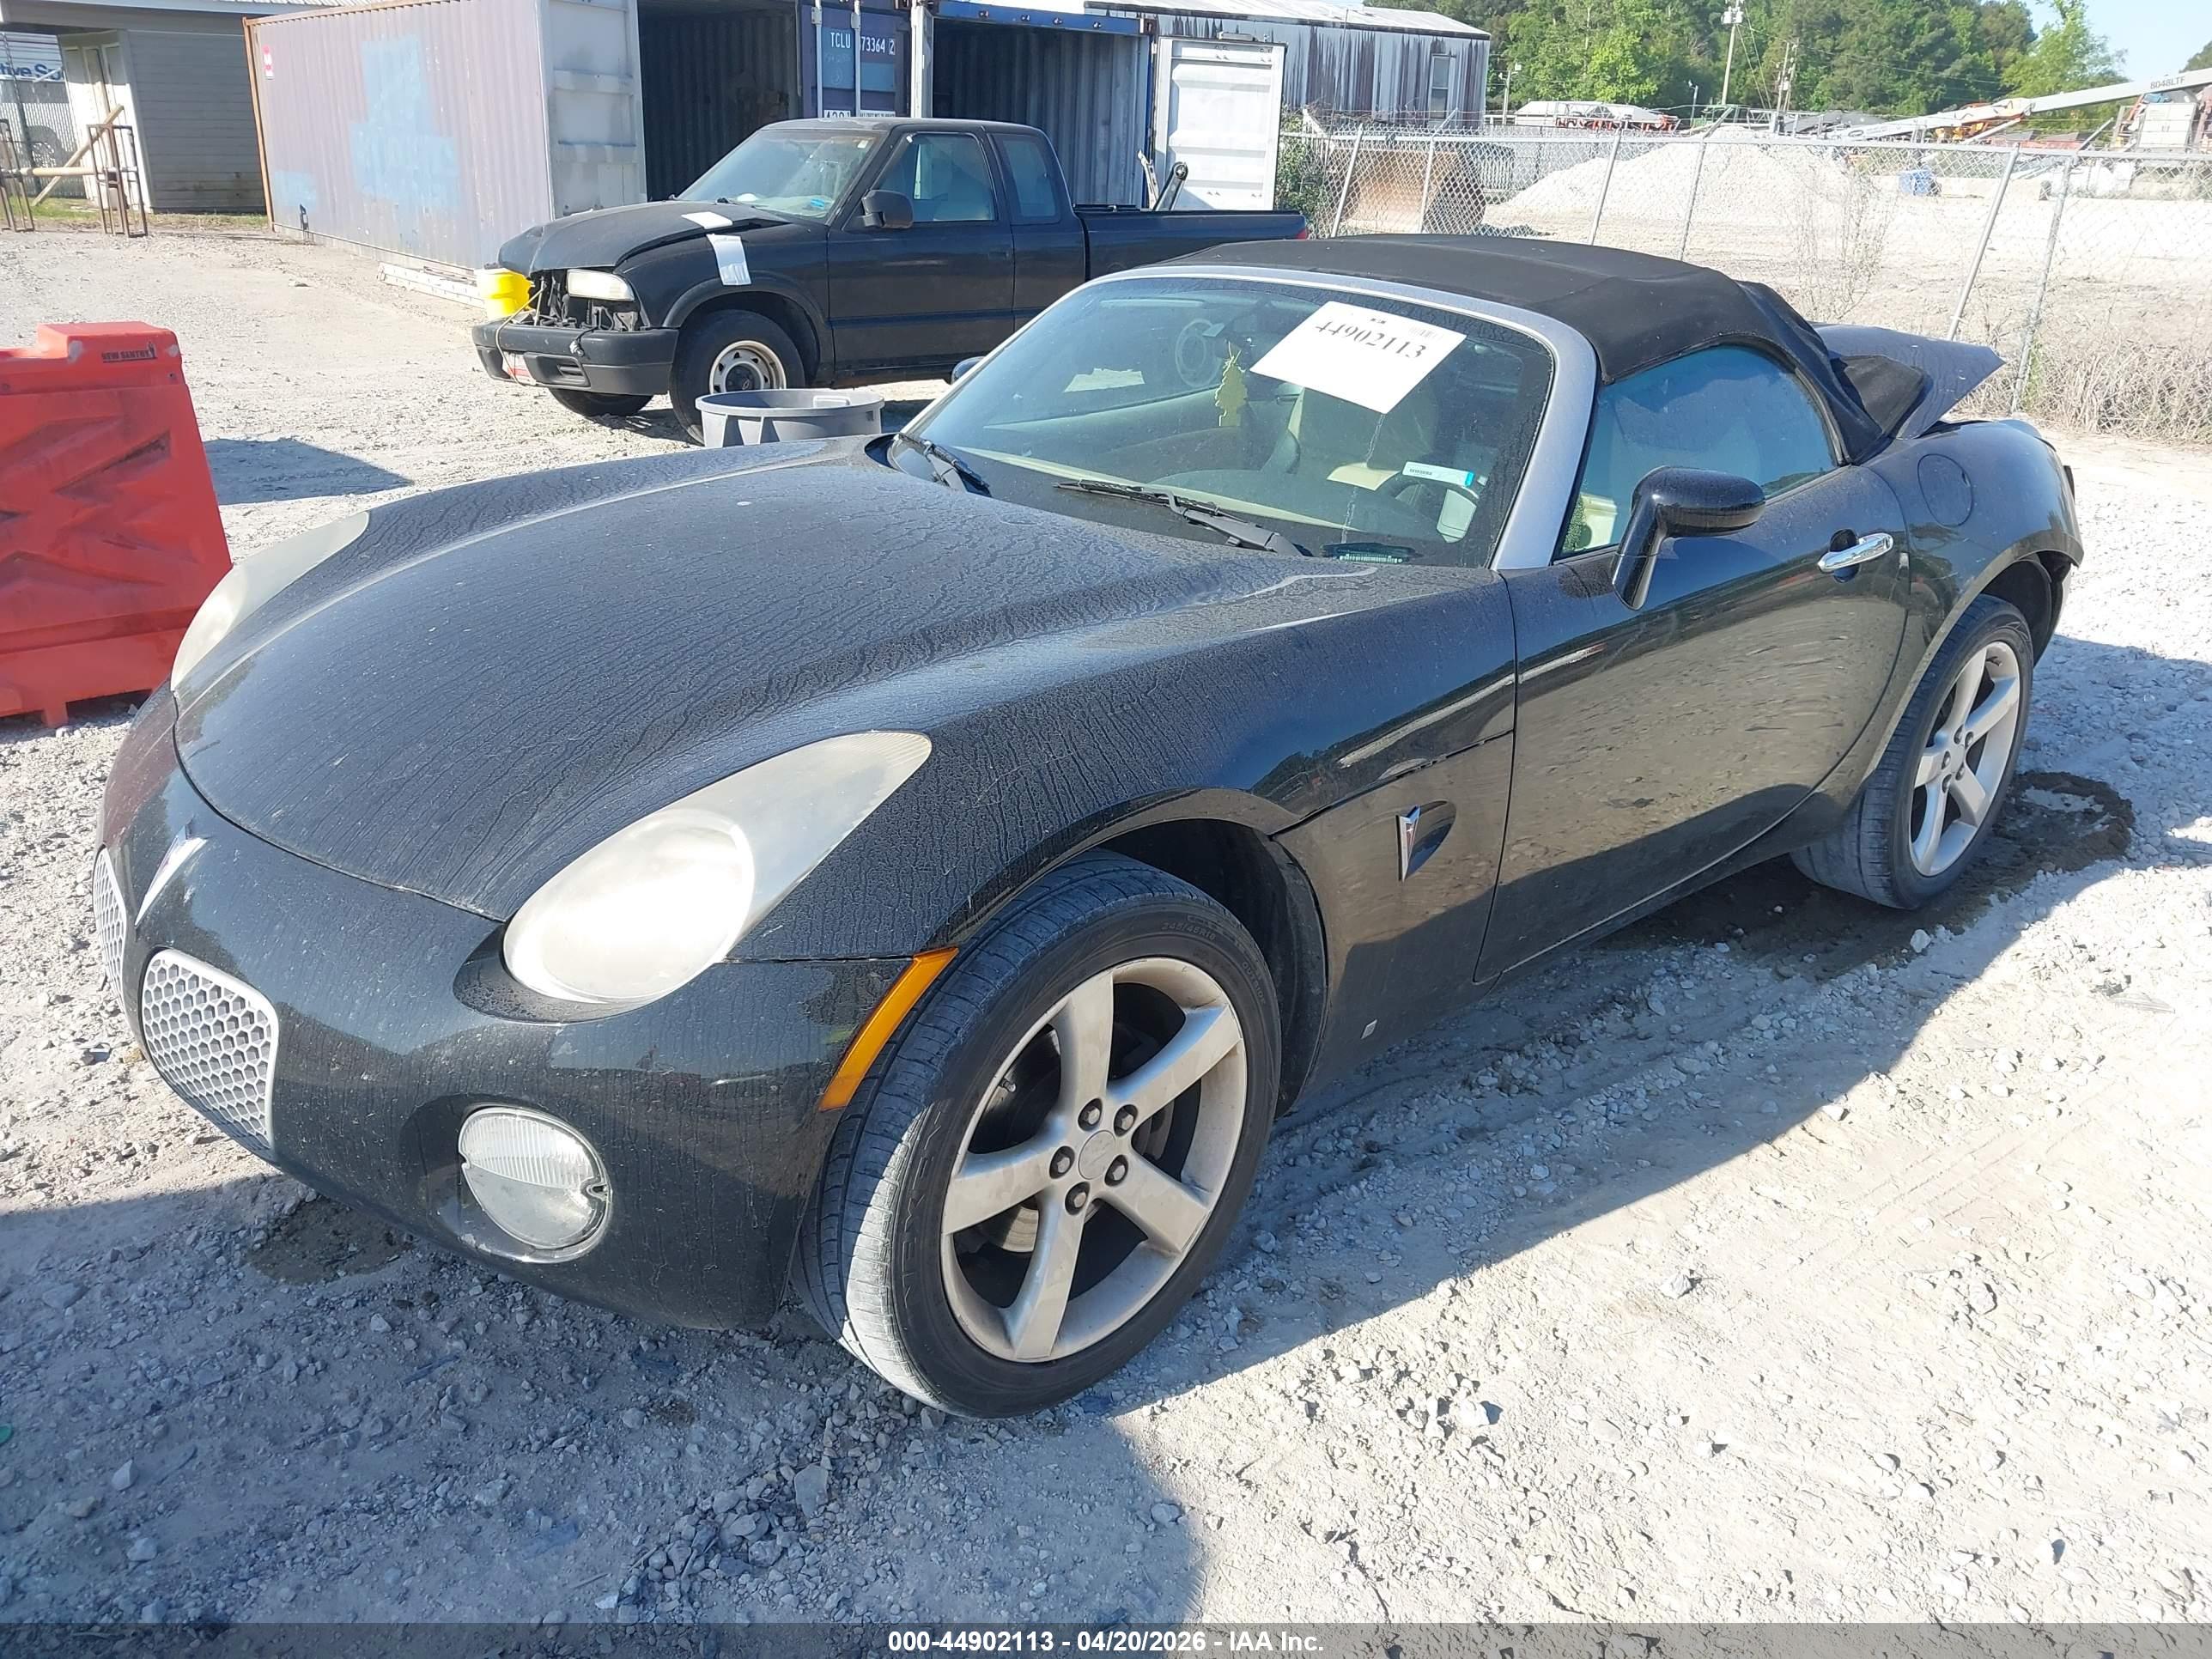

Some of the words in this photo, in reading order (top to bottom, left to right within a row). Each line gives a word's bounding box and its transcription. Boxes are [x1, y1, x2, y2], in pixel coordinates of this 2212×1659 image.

[830, 32, 851, 49] TCLU
[859, 36, 886, 53] 73364
[1316, 320, 1427, 359] 44902113
